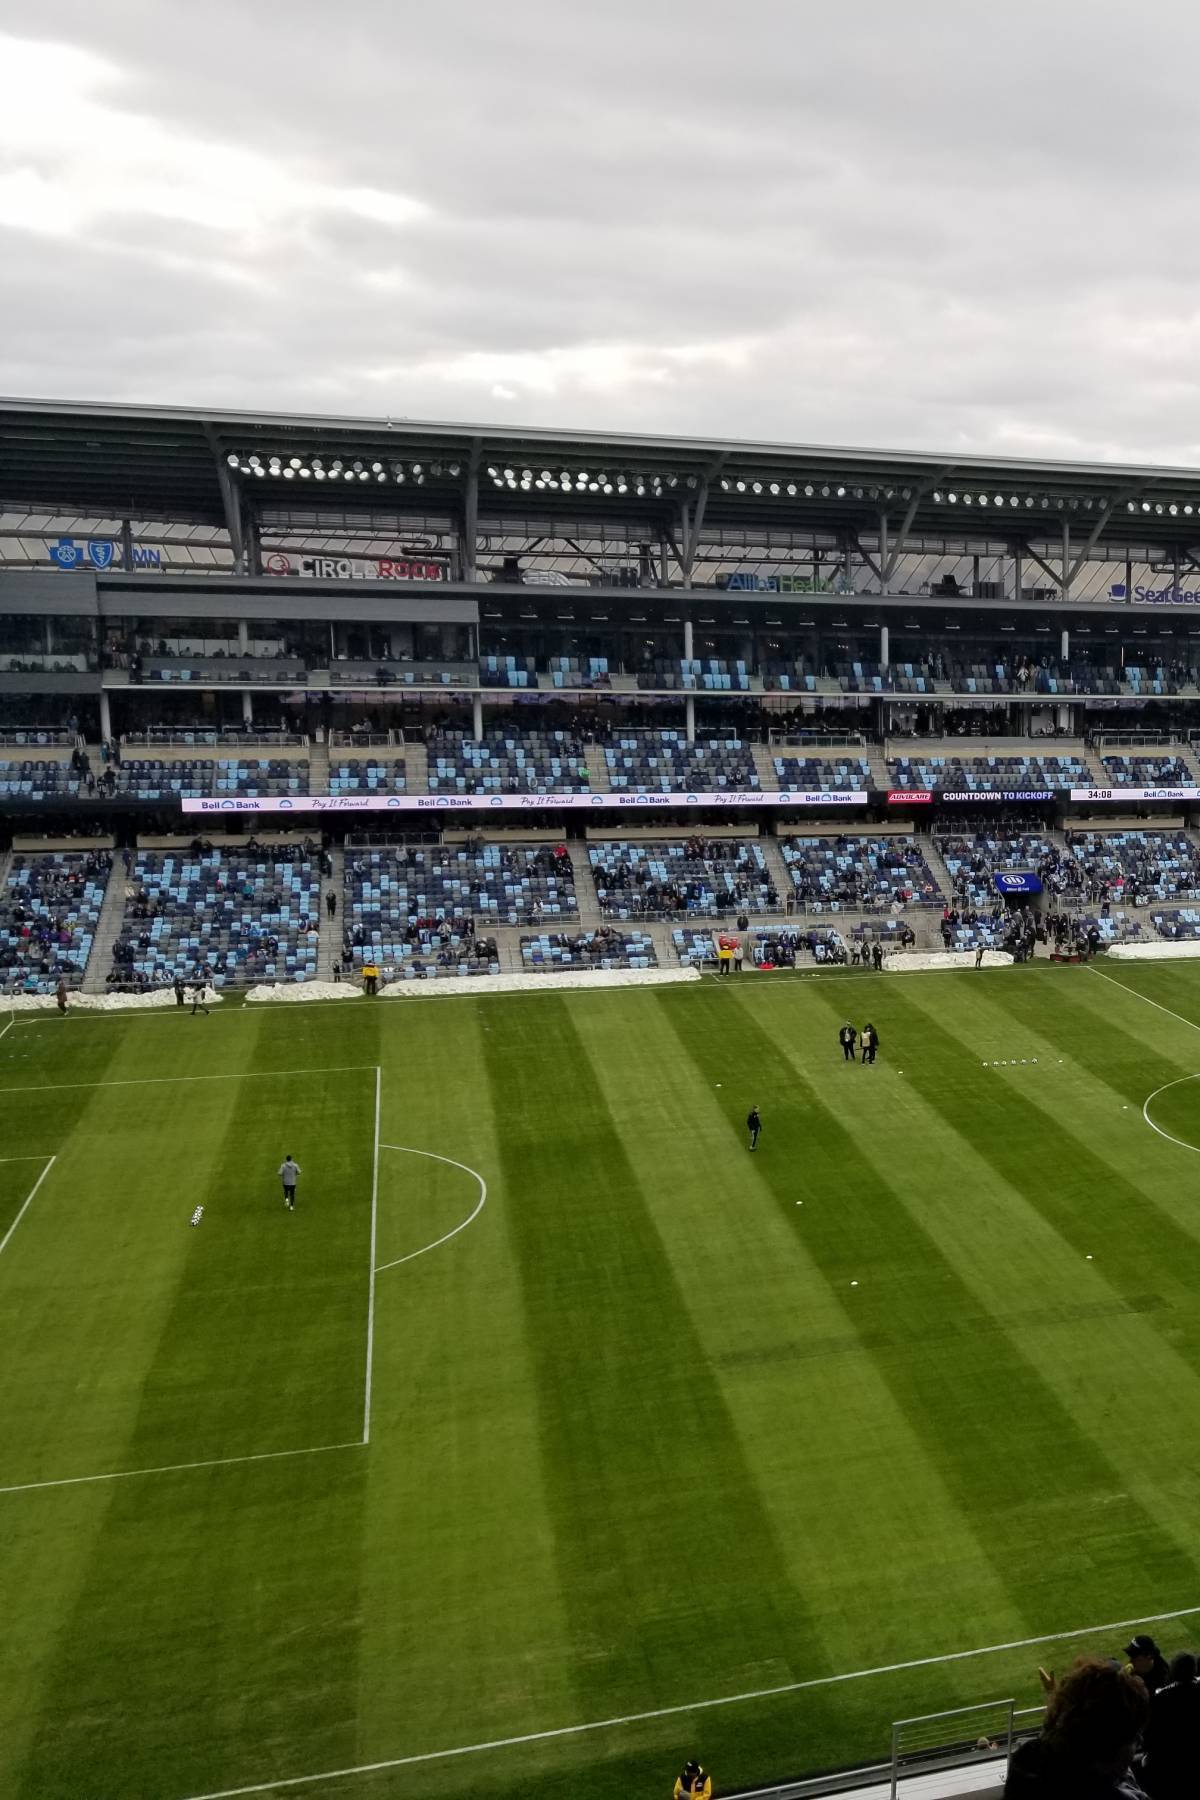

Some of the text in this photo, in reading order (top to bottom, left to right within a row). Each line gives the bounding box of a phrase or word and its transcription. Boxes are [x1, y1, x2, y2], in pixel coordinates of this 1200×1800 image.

[943, 792, 1000, 800] COUNTDOWN
[1016, 792, 1053, 800] KICKOFF
[1088, 790, 1112, 798] 34:08
